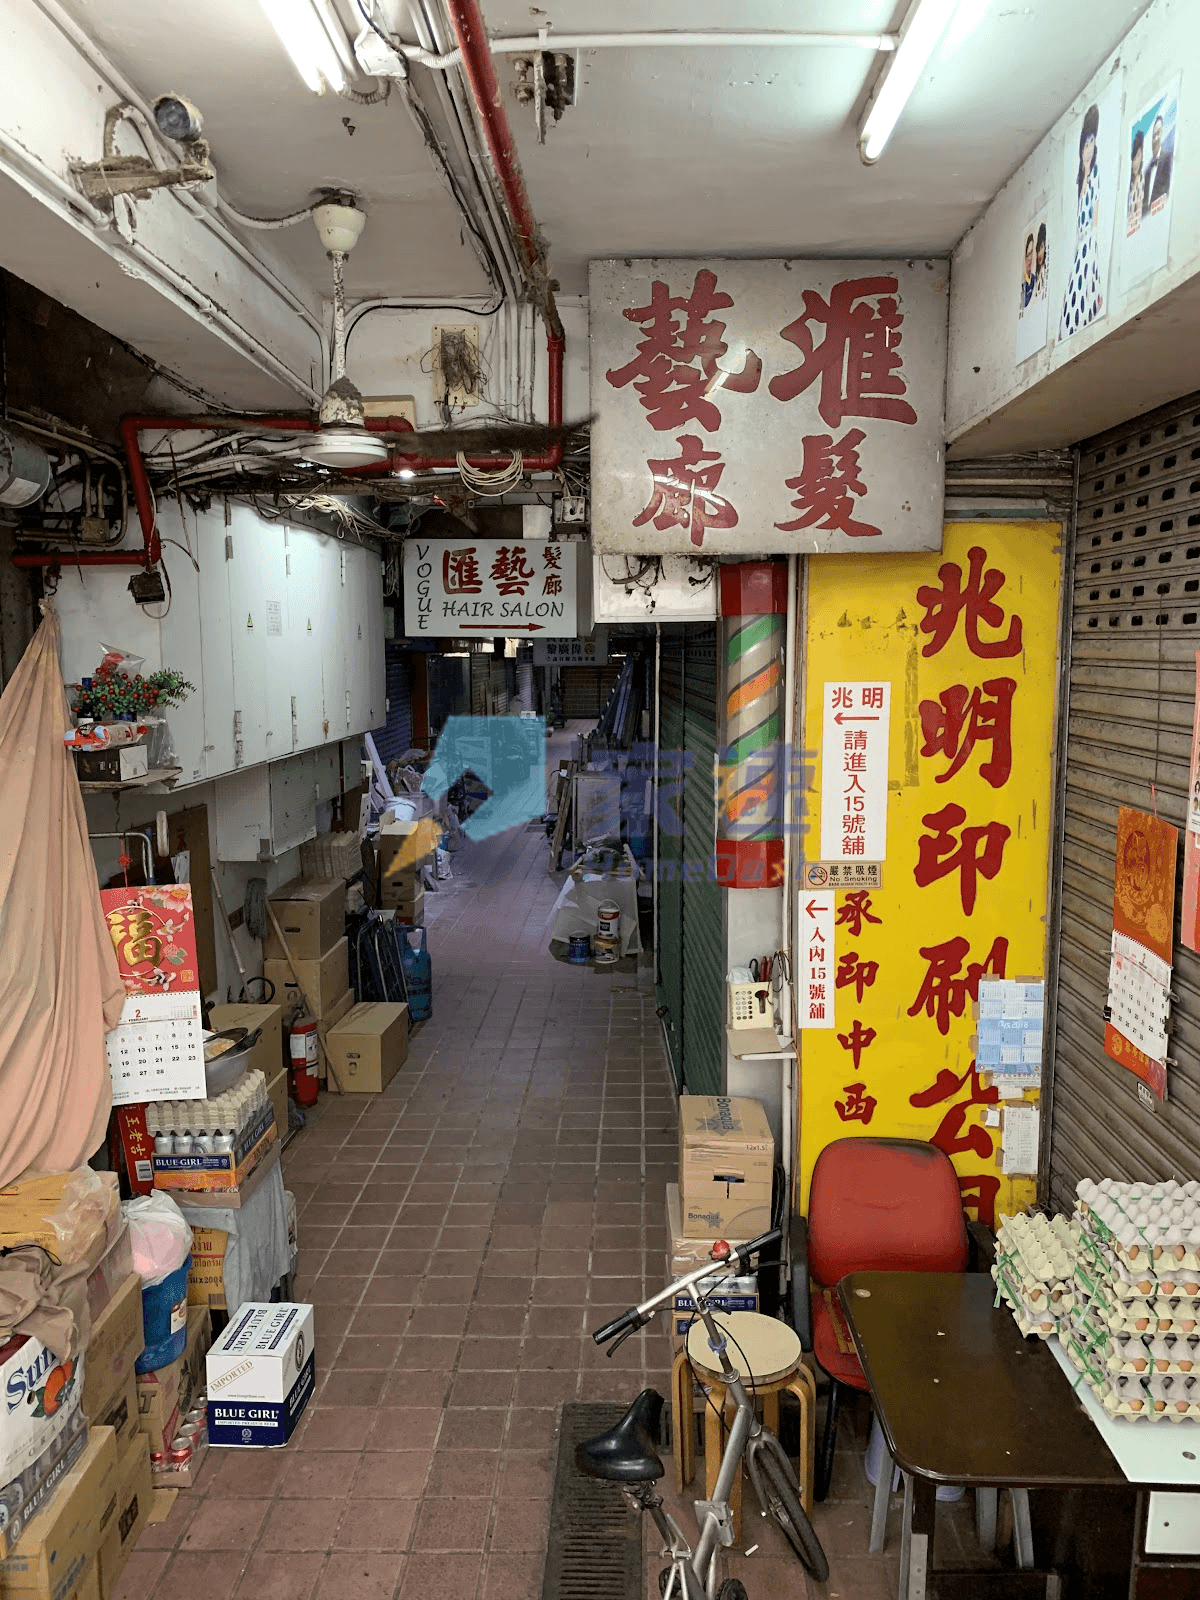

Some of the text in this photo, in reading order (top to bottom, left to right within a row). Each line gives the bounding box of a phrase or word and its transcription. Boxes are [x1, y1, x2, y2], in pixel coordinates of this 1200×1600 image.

[416, 544, 432, 630] VOGUE
[442, 600, 564, 618] HAIR SALON
[135, 1009, 141, 1018] 2
[155, 1158, 178, 1166] BLUE
[179, 1158, 202, 1166] GIRL
[687, 1212, 719, 1221] Bonaqua
[255, 1329, 277, 1350] BLUE
[270, 1308, 289, 1328] GIRL
[210, 1360, 253, 1392] IMPORTED
[214, 1408, 278, 1420] BLUE GIRL
